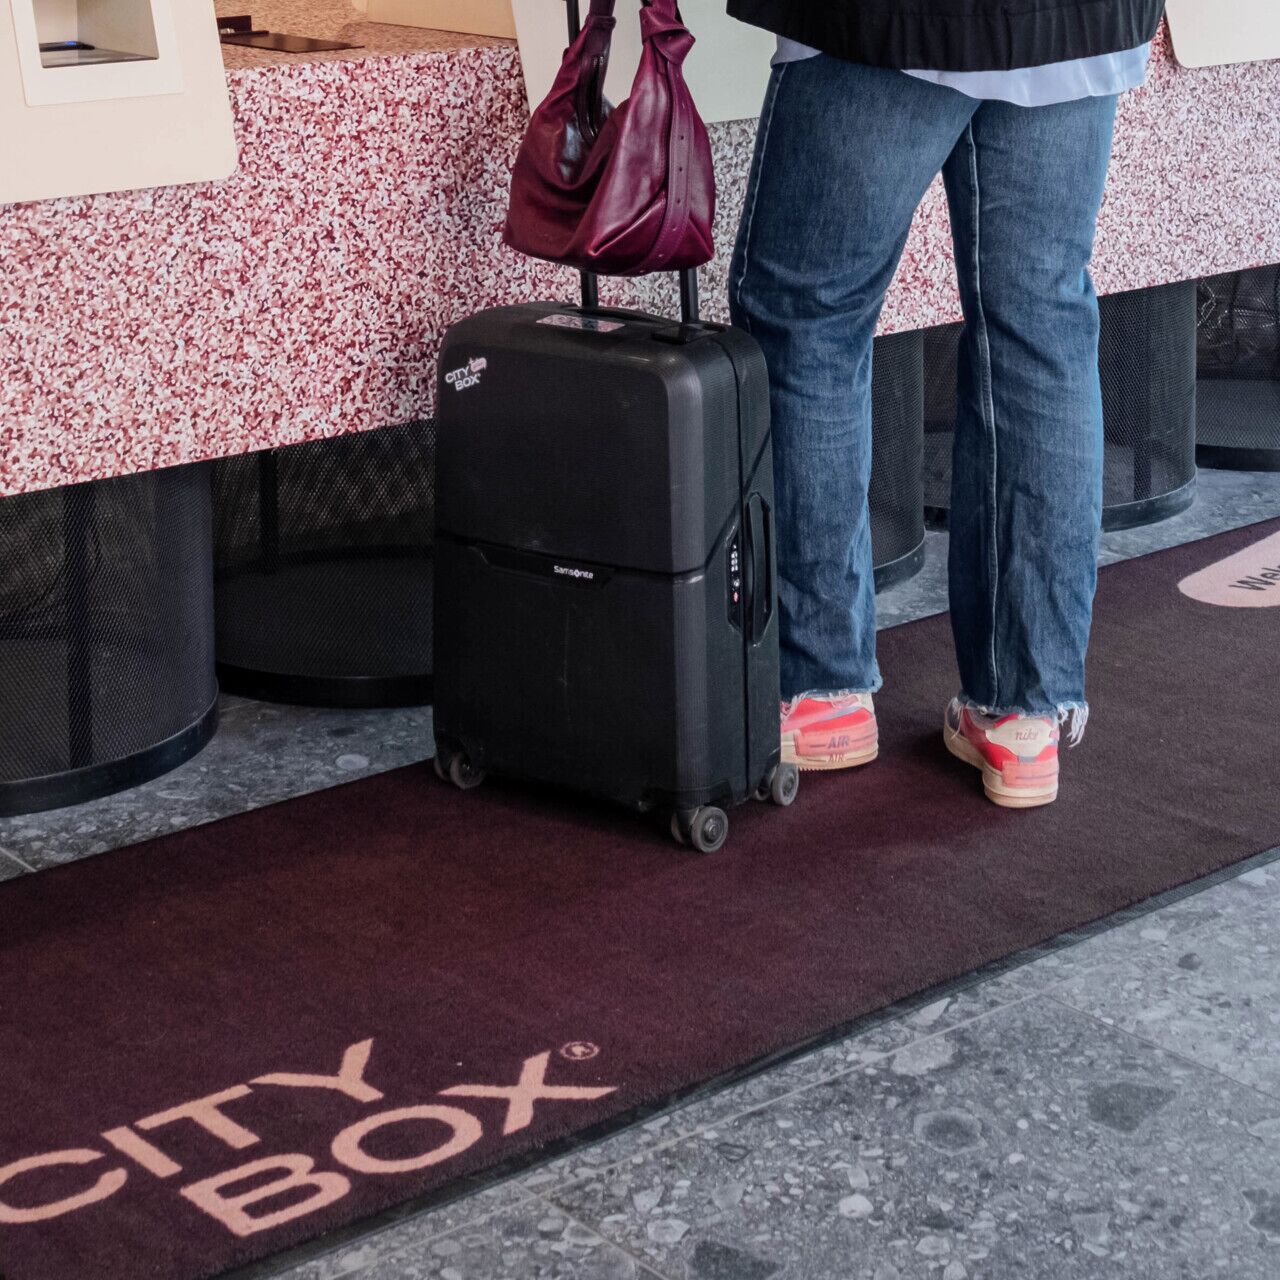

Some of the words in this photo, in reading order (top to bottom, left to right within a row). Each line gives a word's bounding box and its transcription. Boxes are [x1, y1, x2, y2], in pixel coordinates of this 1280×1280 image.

[445, 366, 470, 383] CITY
[553, 565, 594, 579] Samsonite
[828, 735, 850, 748] AIR
